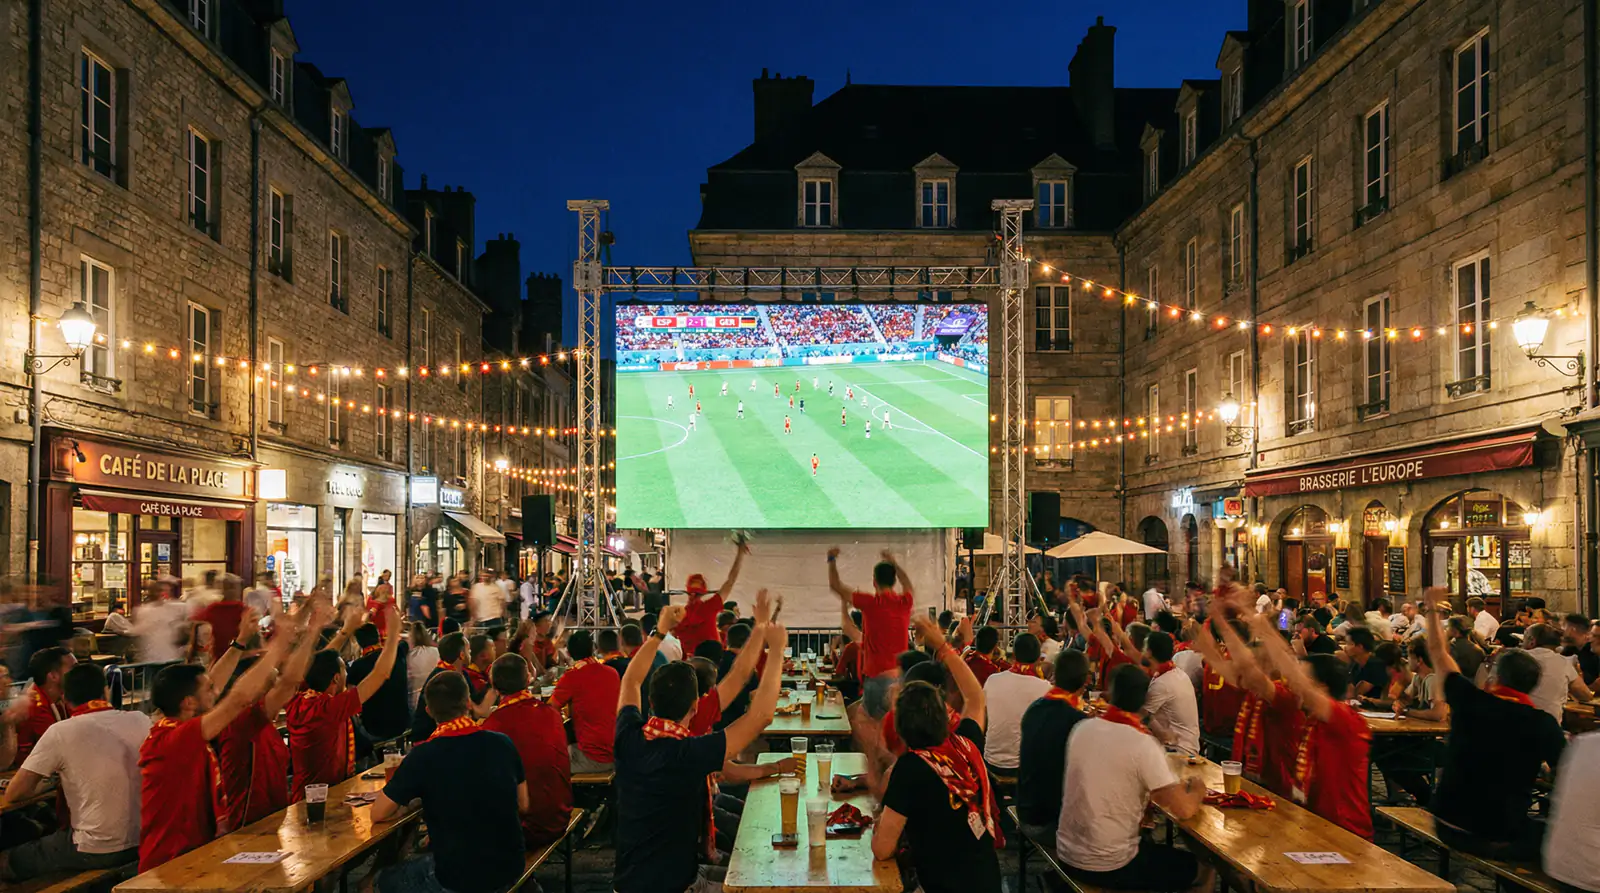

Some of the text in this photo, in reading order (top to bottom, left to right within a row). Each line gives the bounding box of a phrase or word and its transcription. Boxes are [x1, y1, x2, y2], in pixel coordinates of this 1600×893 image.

[656, 318, 673, 326] ESP
[719, 318, 736, 326] GER
[99, 453, 229, 489] CAFÉ DE LA PLACE
[1299, 460, 1424, 491] BRASSERIE L'EUROPE
[160, 504, 171, 515] DE
[171, 506, 181, 515] LA
[181, 506, 203, 517] PLACE
